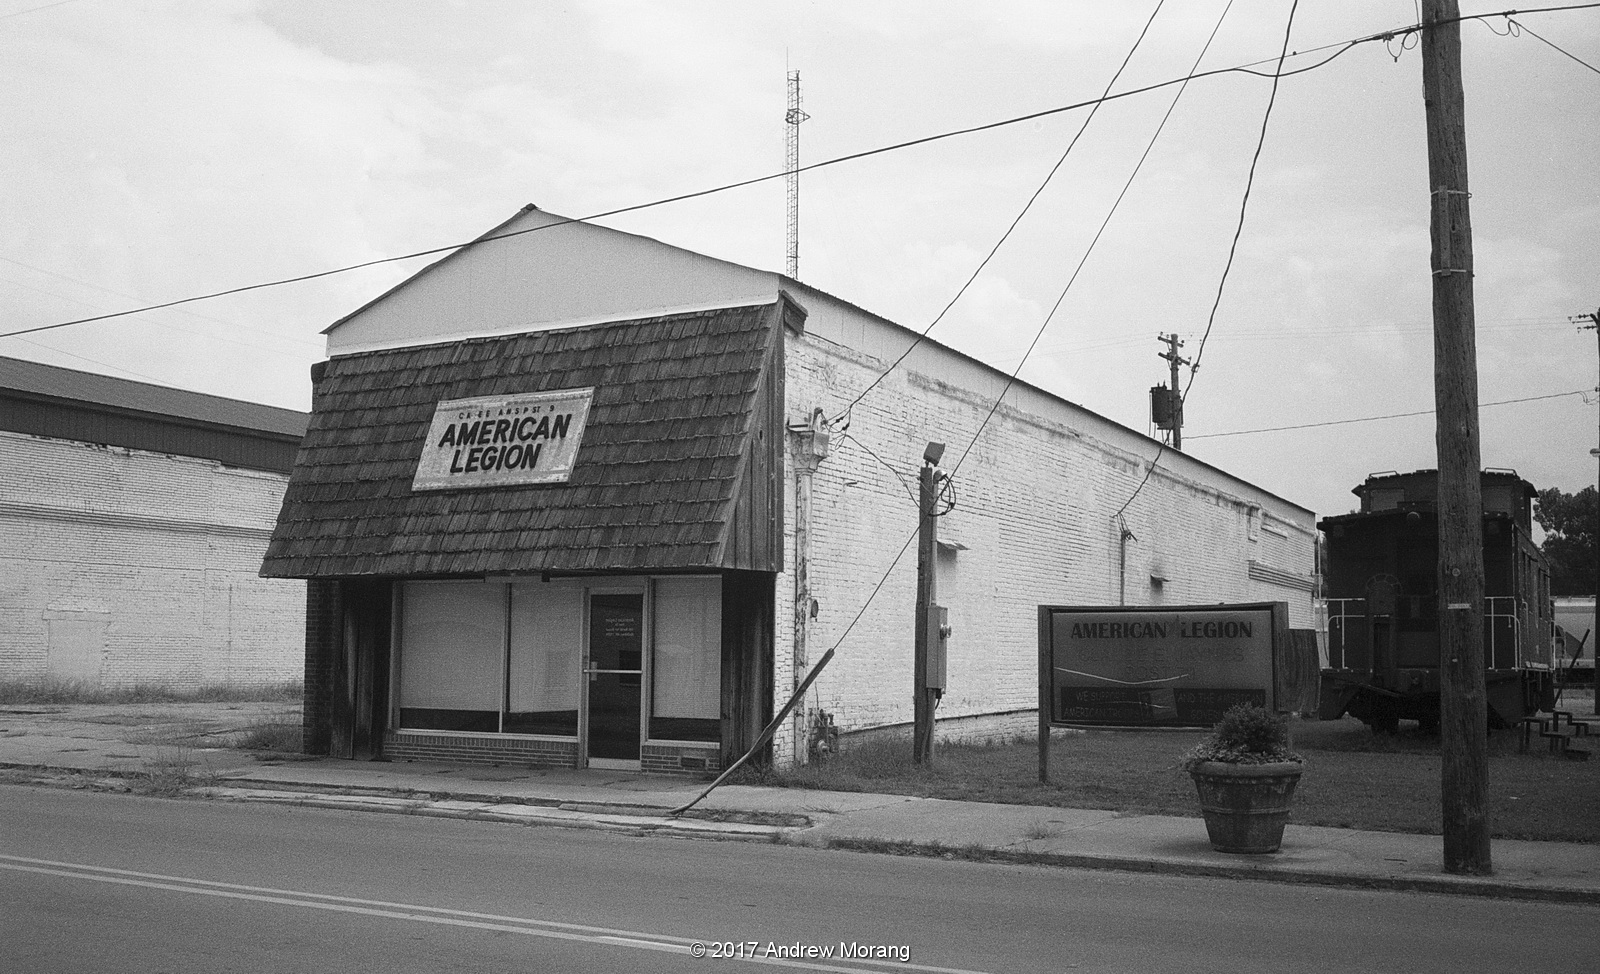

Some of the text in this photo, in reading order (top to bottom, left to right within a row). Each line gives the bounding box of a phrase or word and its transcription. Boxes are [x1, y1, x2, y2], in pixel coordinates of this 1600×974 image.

[438, 413, 573, 448] AMERICAN
[450, 443, 543, 474] LEGION
[1070, 621, 1252, 639] AMERICAN LEGION
